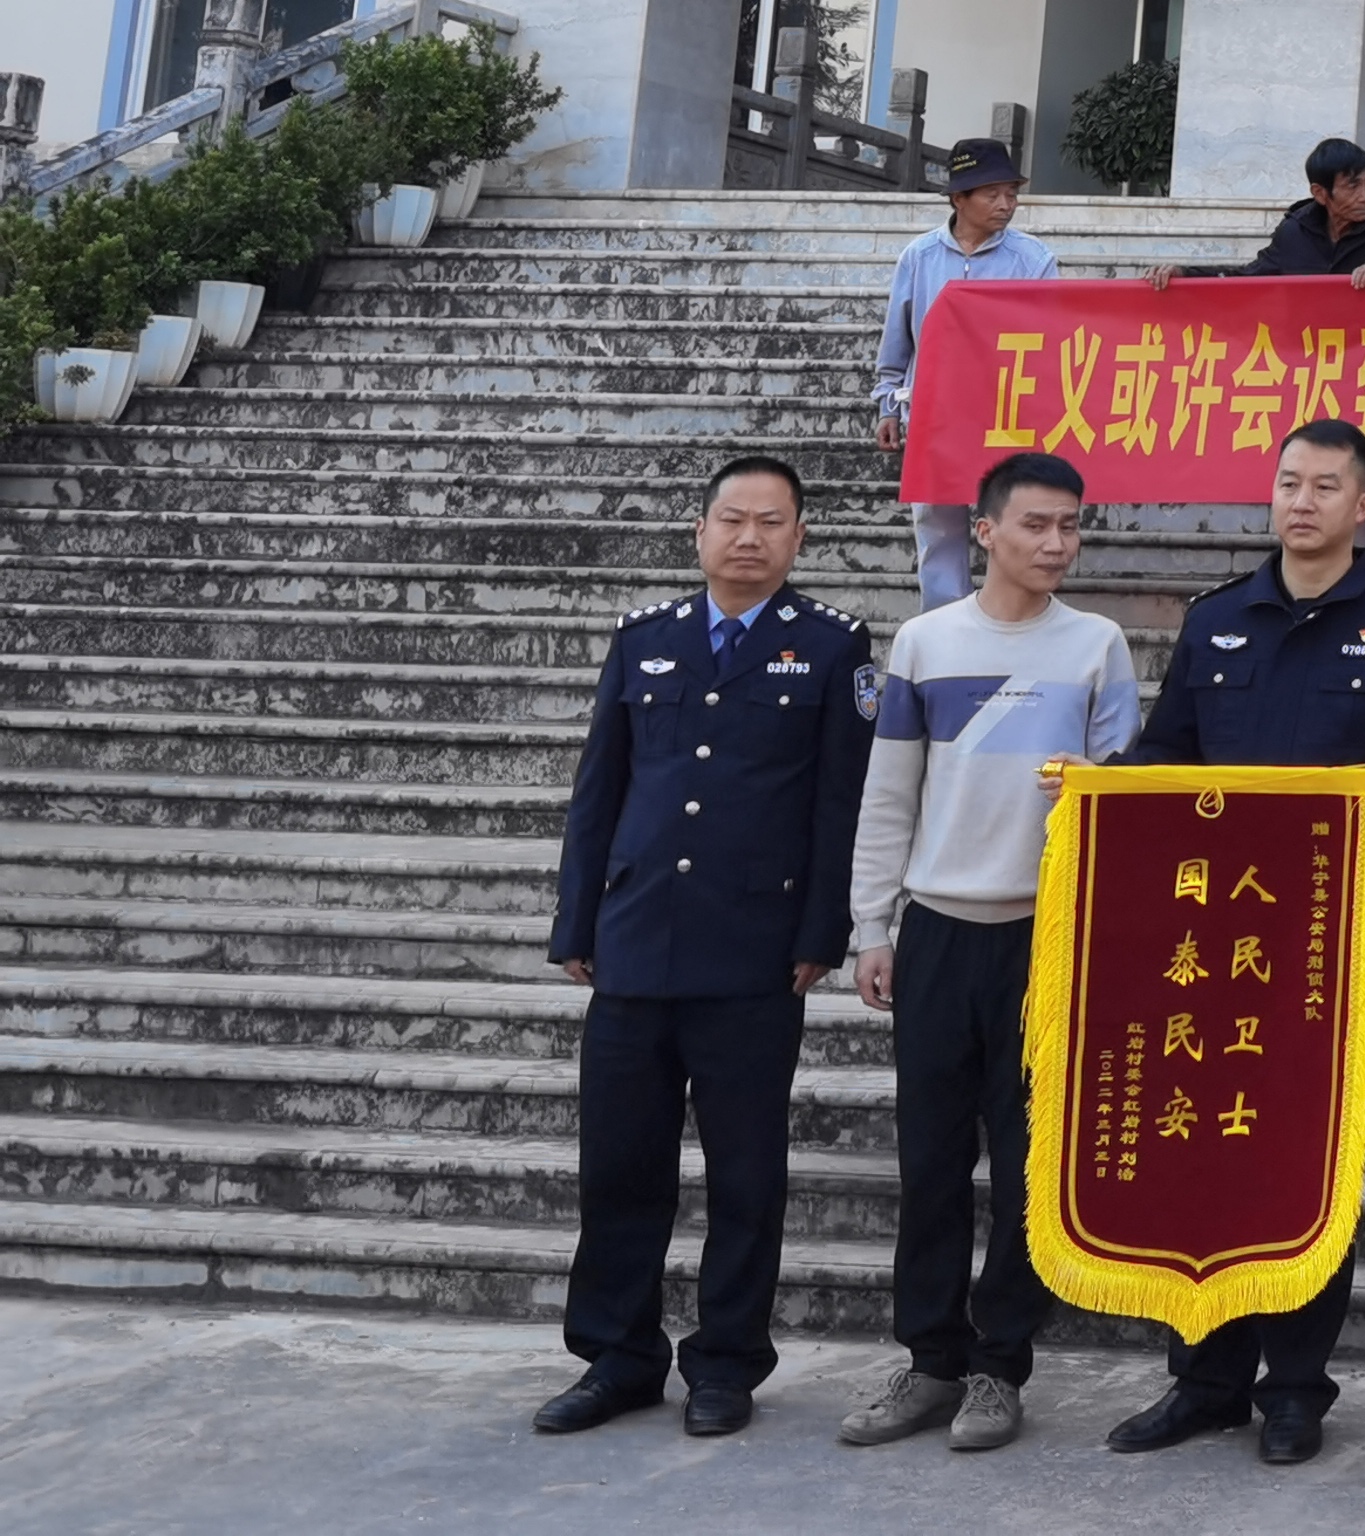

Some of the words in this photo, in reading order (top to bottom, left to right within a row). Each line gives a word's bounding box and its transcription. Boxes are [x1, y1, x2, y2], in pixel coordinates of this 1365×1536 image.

[1155, 858, 1210, 1140] 国泰民安
[1217, 864, 1277, 1138] 人民卫士
